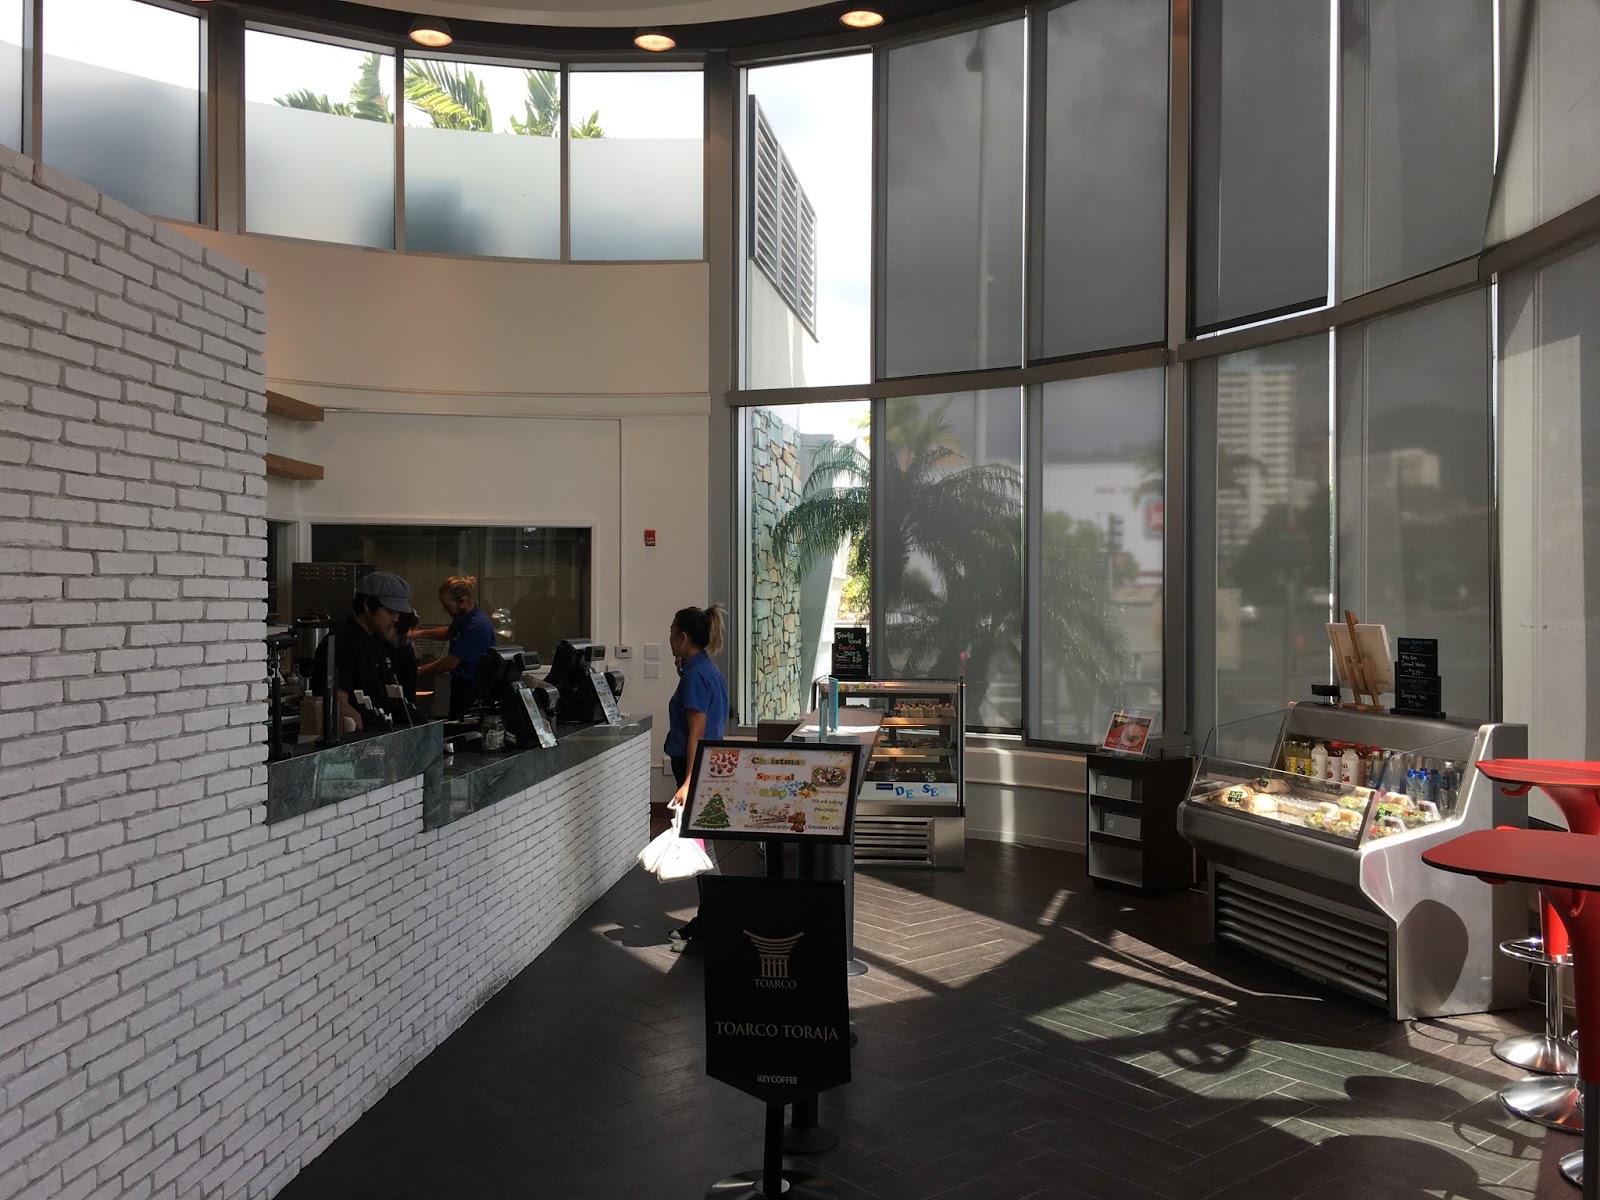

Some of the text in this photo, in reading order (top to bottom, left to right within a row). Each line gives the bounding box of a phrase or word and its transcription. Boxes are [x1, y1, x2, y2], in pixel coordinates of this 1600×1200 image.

[752, 757, 806, 766] Cistma
[756, 772, 795, 781] Spcal
[895, 784, 955, 799] DESE
[754, 978, 797, 989] TOARCO
[714, 1021, 839, 1042] TOARCO TORAJA
